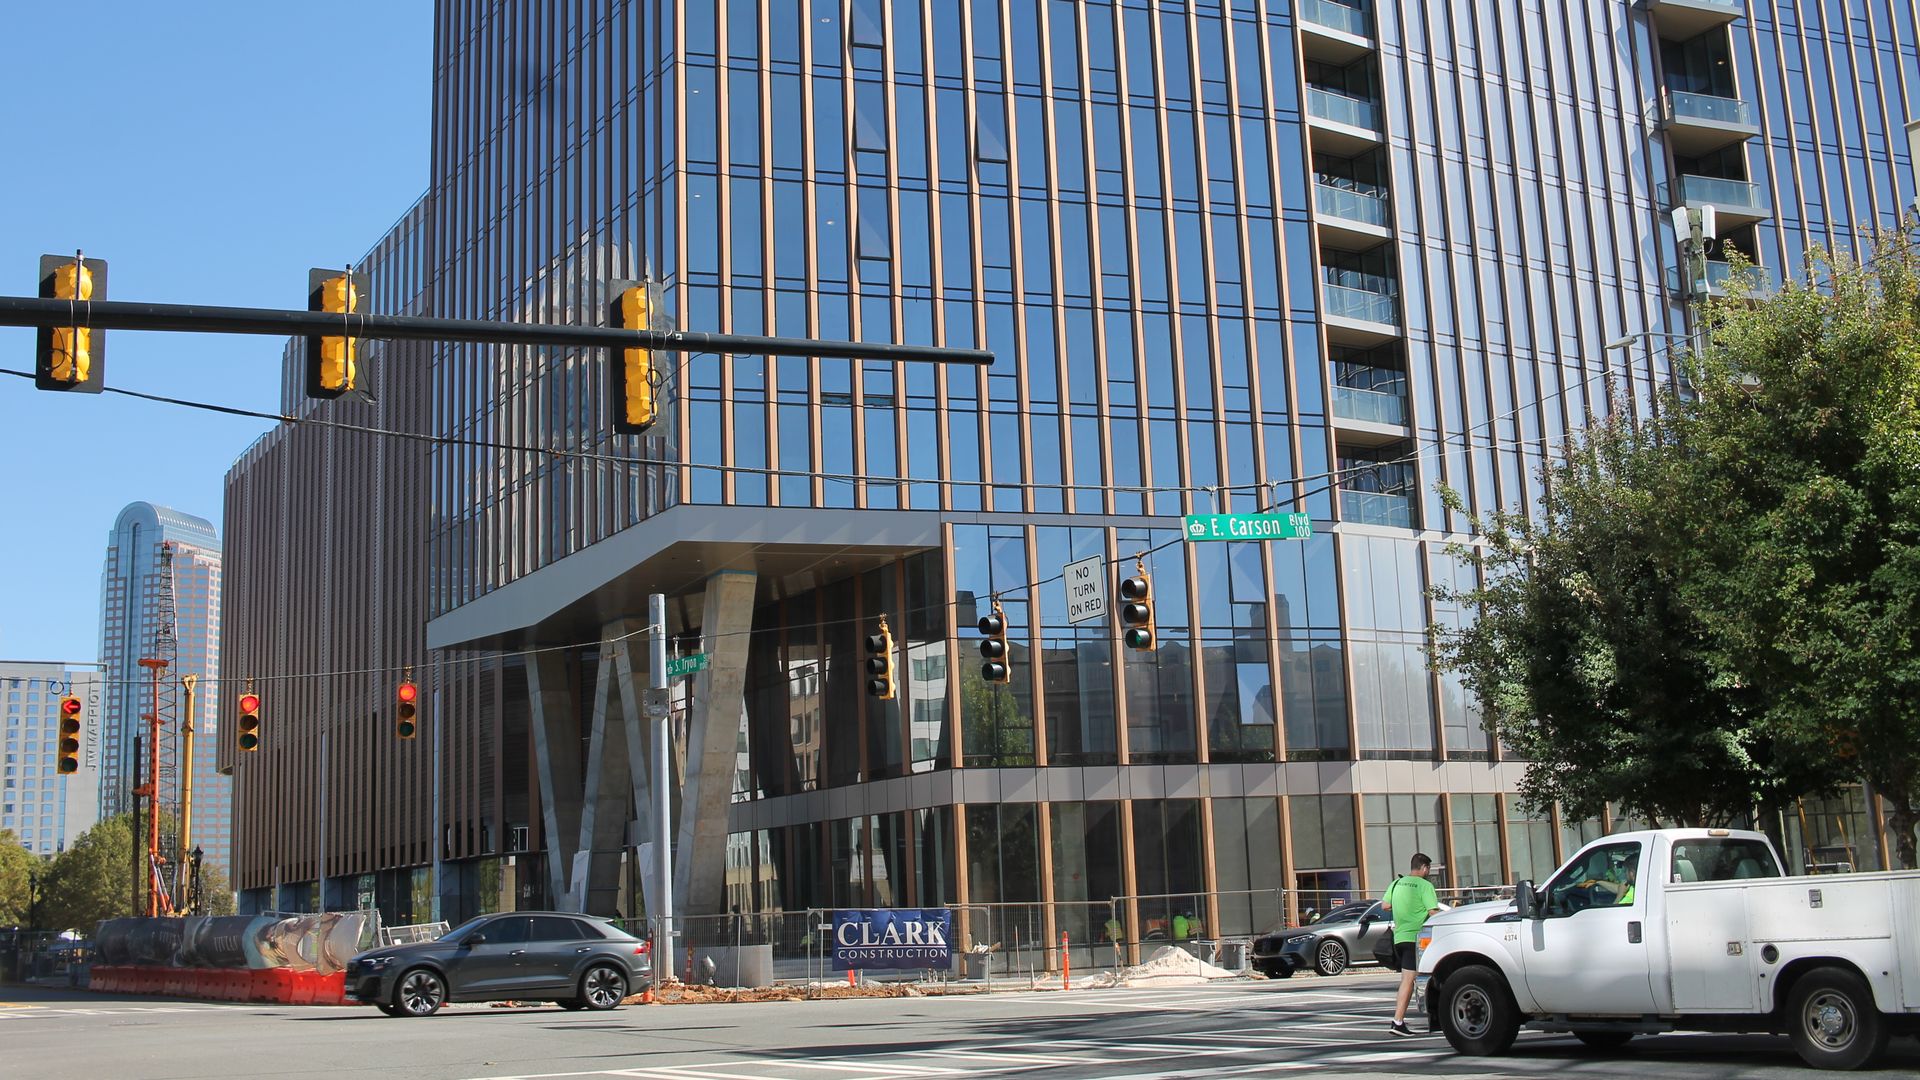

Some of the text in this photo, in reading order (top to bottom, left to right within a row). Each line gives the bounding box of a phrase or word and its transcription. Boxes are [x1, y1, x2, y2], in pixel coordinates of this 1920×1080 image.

[1210, 513, 1309, 537] E. Carson Blvd
[1294, 525, 1311, 537] 100
[1075, 566, 1090, 580] NO
[1073, 582, 1096, 598] TURN
[1070, 597, 1102, 617] ON RED
[682, 657, 697, 673] Tryon
[837, 921, 947, 946] CLARK
[838, 949, 948, 960] CONSTRUCTION
